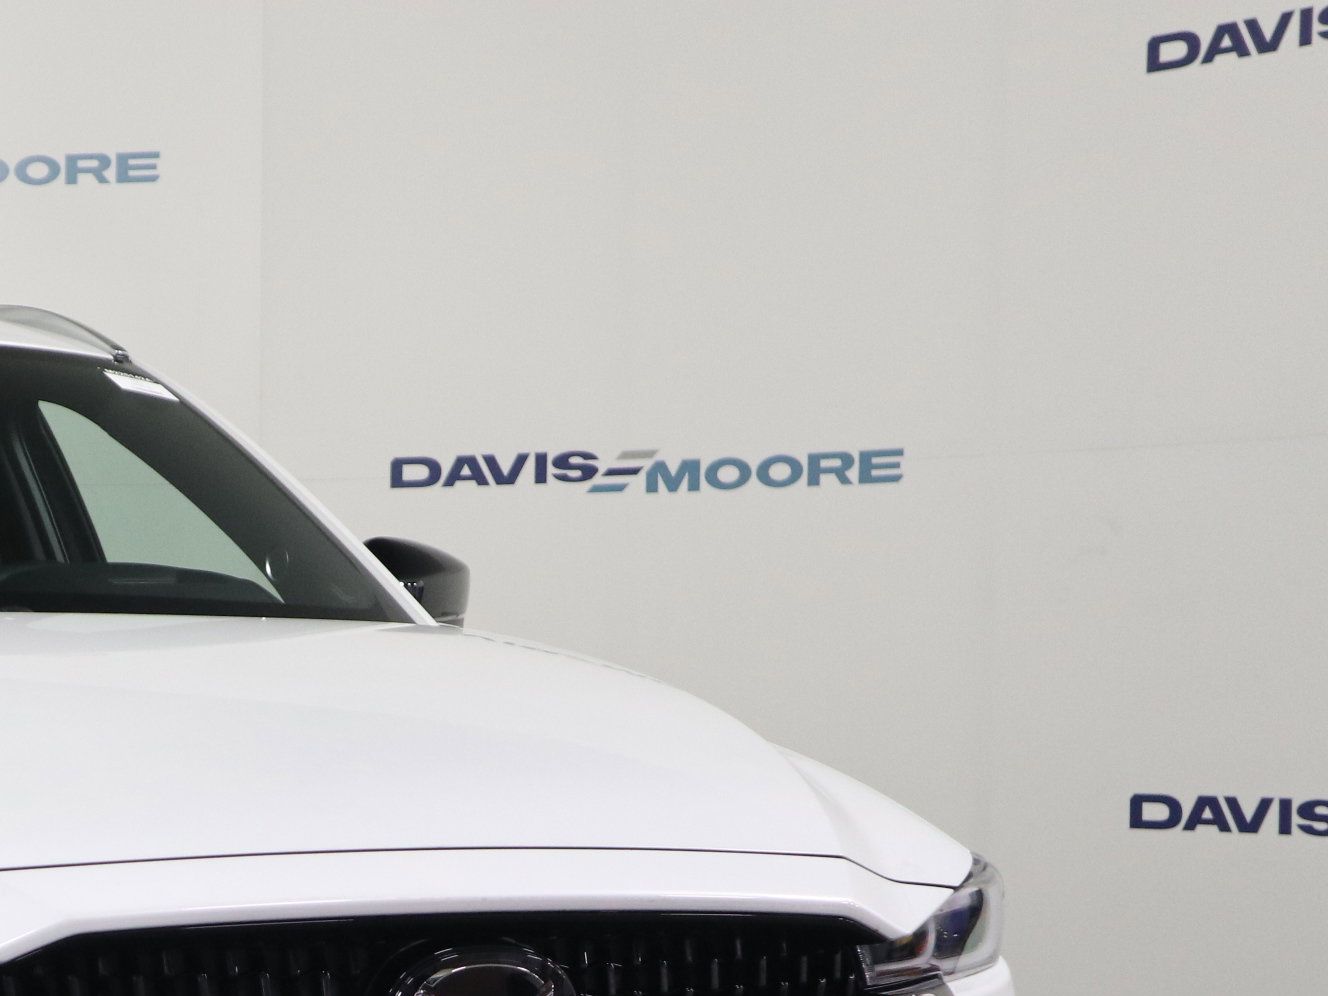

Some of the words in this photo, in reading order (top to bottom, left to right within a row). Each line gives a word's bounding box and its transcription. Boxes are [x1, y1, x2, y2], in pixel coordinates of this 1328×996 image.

[1146, 5, 1328, 74] DAVI
[389, 450, 600, 490] DAVIS
[645, 448, 905, 493] MOORE
[1129, 793, 1328, 838] DAVIS
